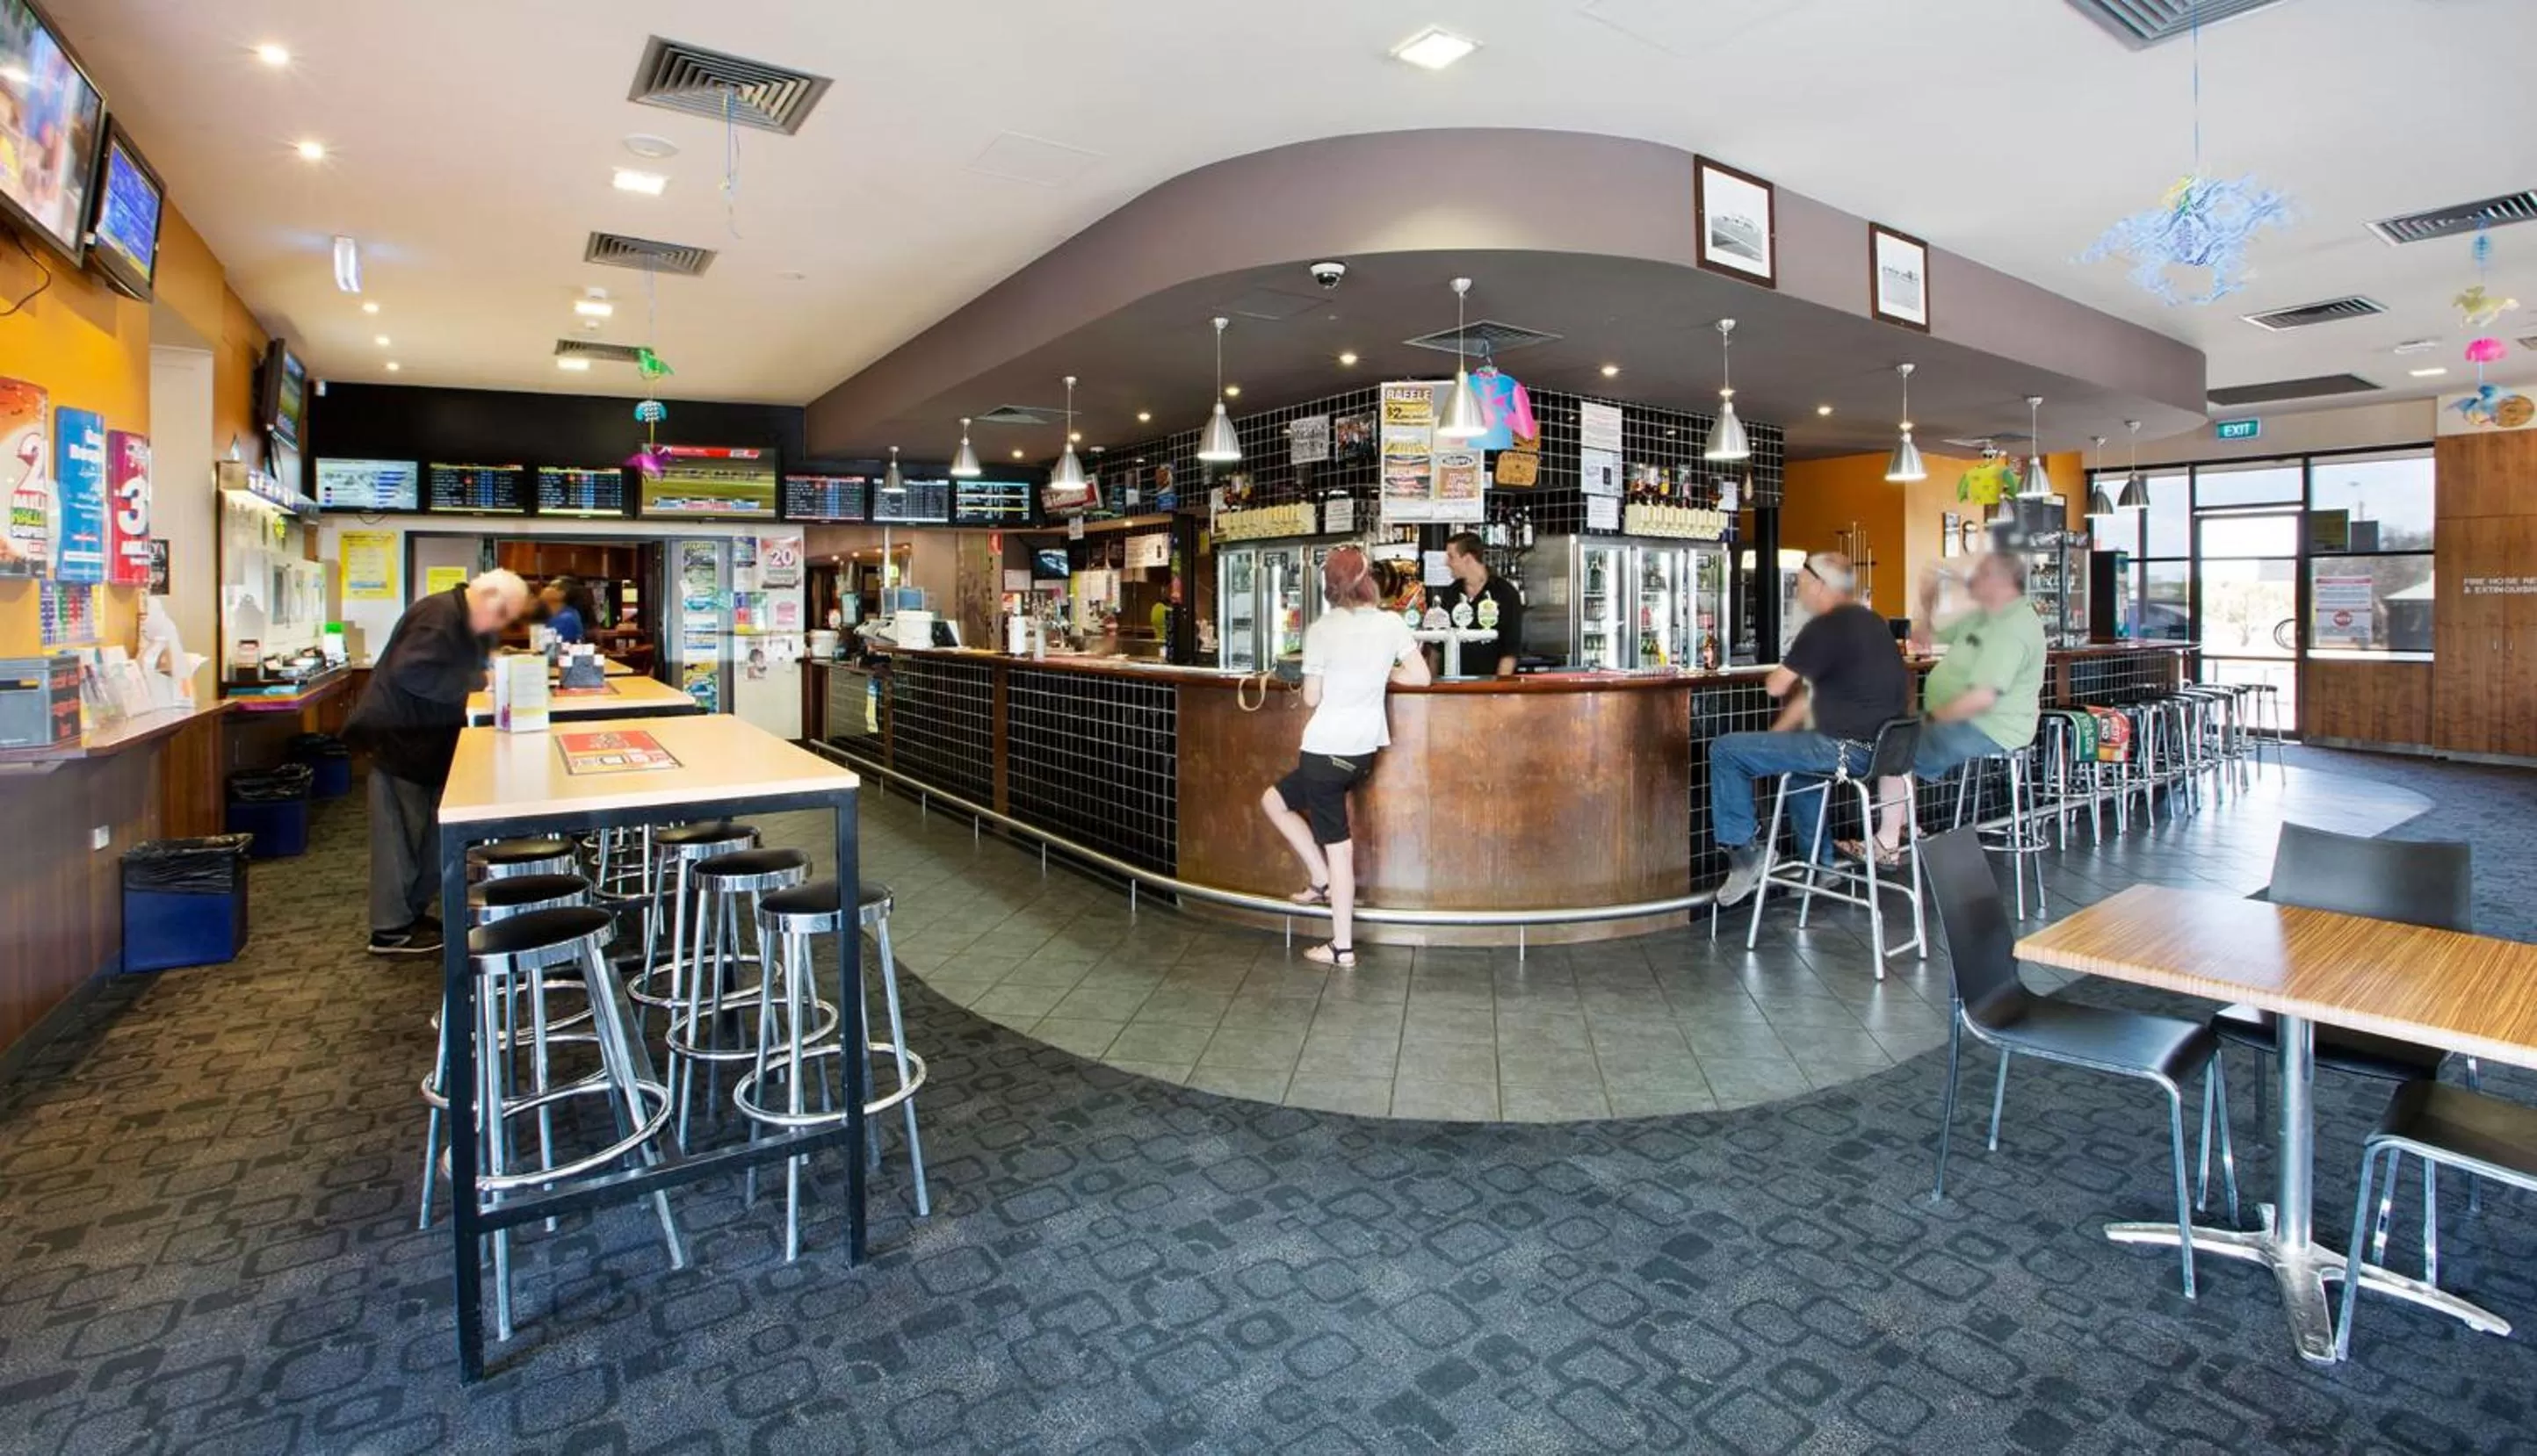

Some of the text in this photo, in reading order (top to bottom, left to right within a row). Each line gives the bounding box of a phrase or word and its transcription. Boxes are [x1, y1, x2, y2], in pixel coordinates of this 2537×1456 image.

[1386, 388, 1431, 400] RAFFLE
[1386, 405, 1402, 419] $2
[2223, 423, 2251, 437] EXIT
[770, 550, 794, 566] 20
[2462, 577, 2484, 586] FIRE
[2488, 577, 2519, 586] HOSE
